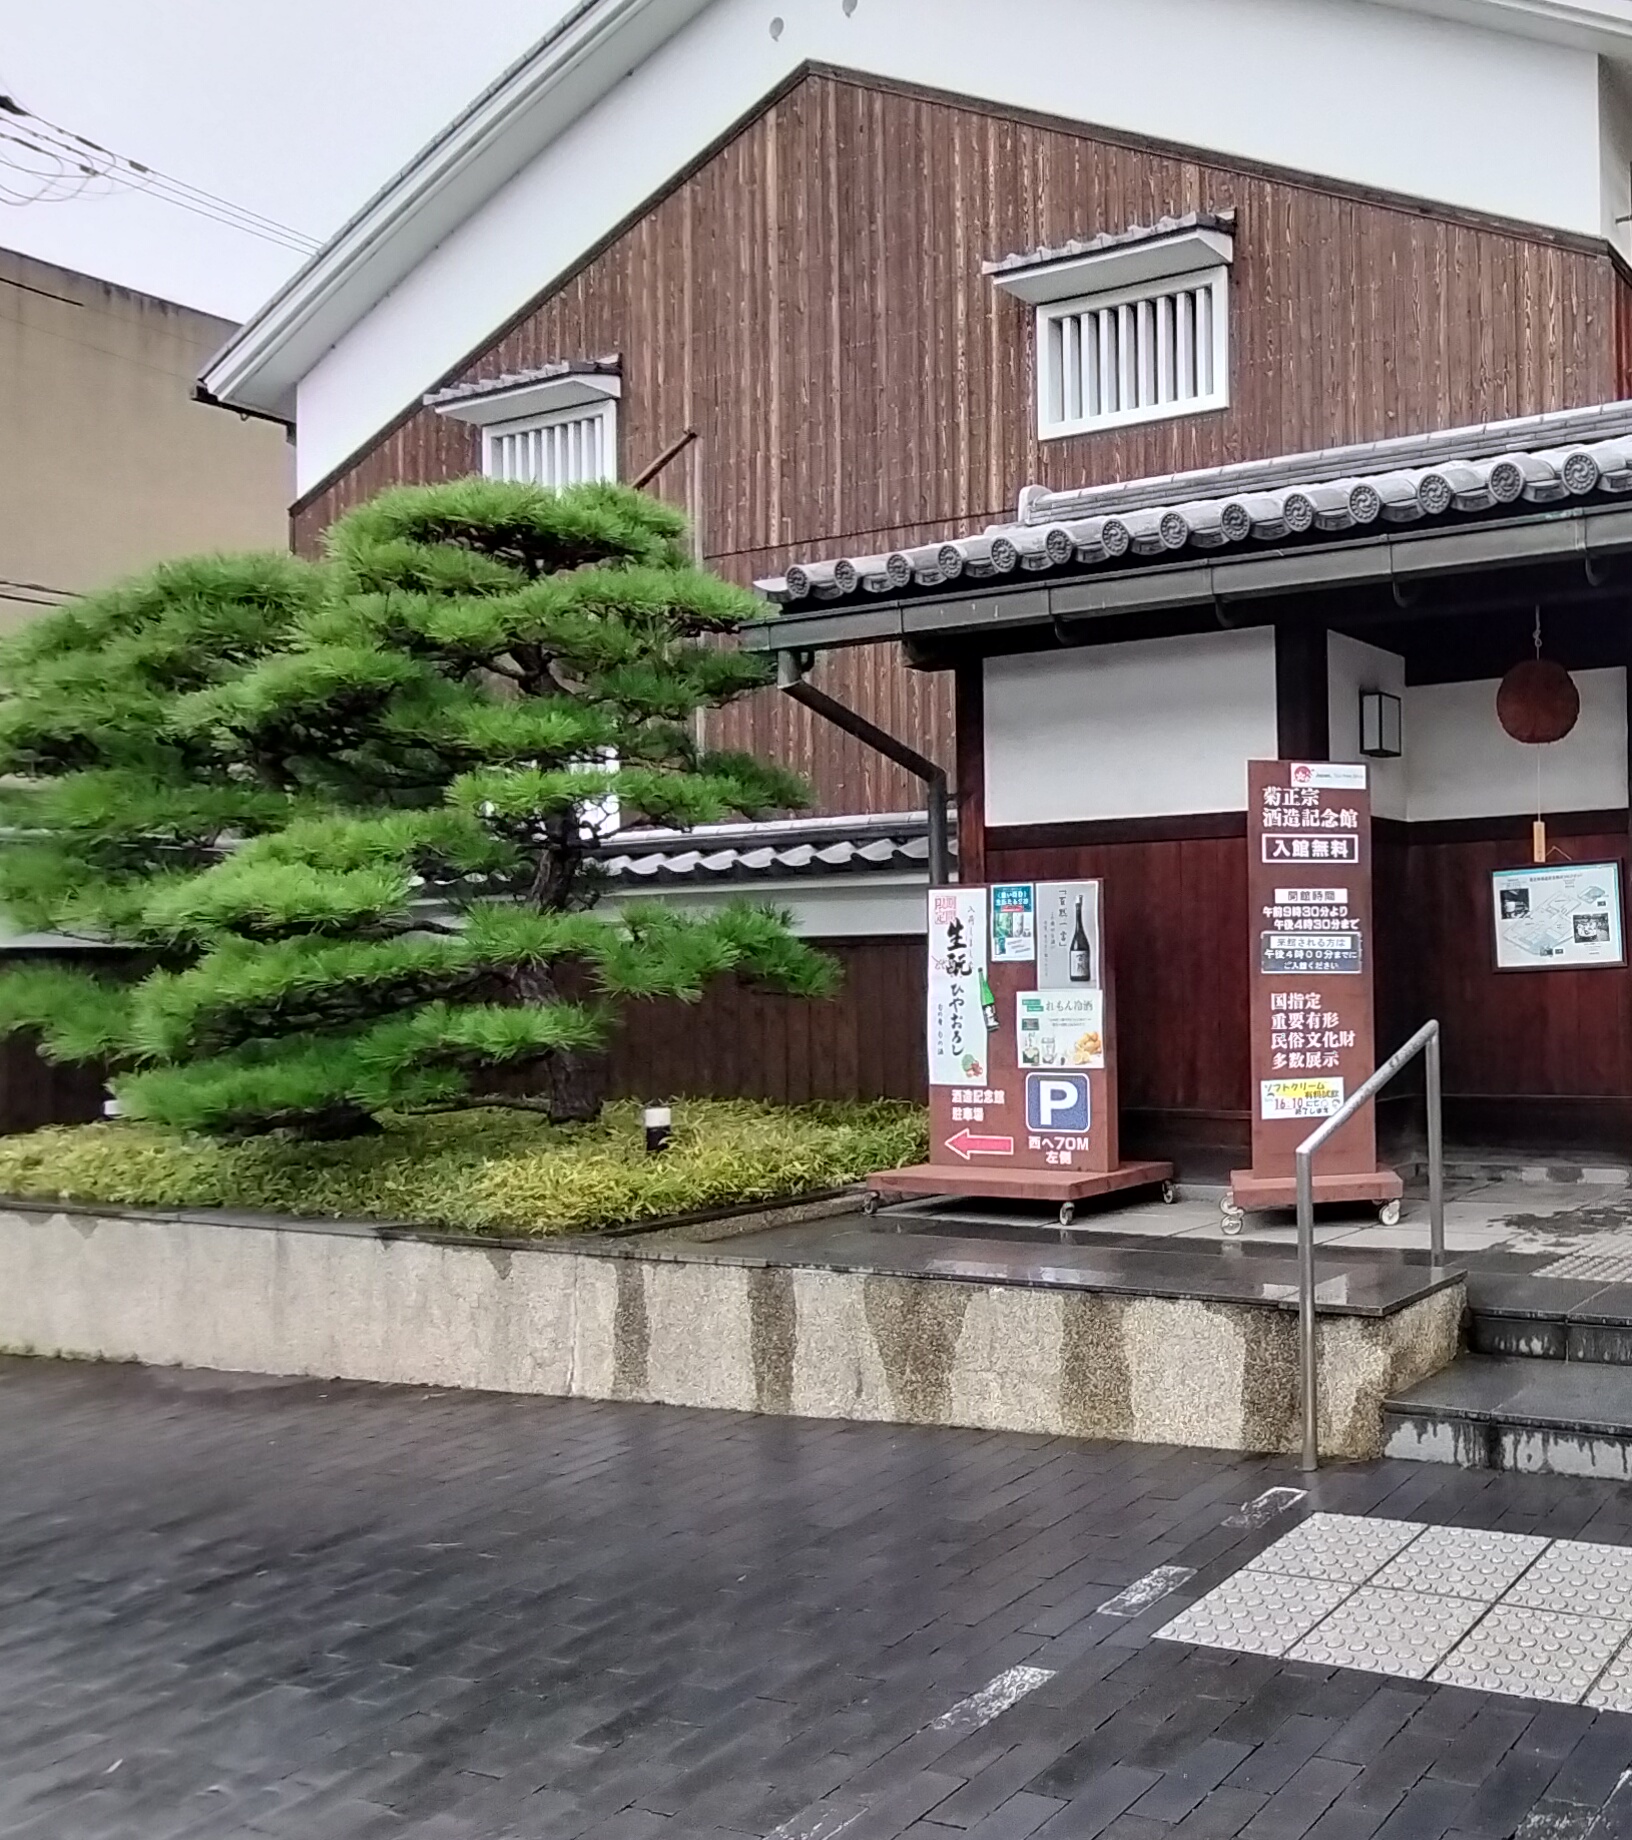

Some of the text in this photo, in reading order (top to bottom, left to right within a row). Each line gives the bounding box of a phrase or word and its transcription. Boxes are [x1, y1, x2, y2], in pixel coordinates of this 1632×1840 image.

[1262, 786, 1320, 806] 菊正宗
[1262, 808, 1359, 828] 酒造記念館
[1272, 839, 1348, 858] 入館無料
[1288, 891, 1335, 901] 開館時間
[1262, 906, 1348, 918] 午前9時30分より
[1274, 918, 1360, 930] 午後4時30分まで
[1046, 1000, 1093, 1011] れもん冷酒
[1271, 992, 1321, 1010] 国指定
[1271, 1012, 1339, 1030] 重要有形
[1271, 1030, 1356, 1049] 民俗文化財
[1272, 1051, 1339, 1070] 多数展示
[952, 1089, 1005, 1104] 酒造記念館
[1040, 1080, 1078, 1125] P
[952, 1107, 984, 1121] 駐車場
[1028, 1136, 1089, 1151] 西へ70M
[1046, 1151, 1072, 1164] 左側
